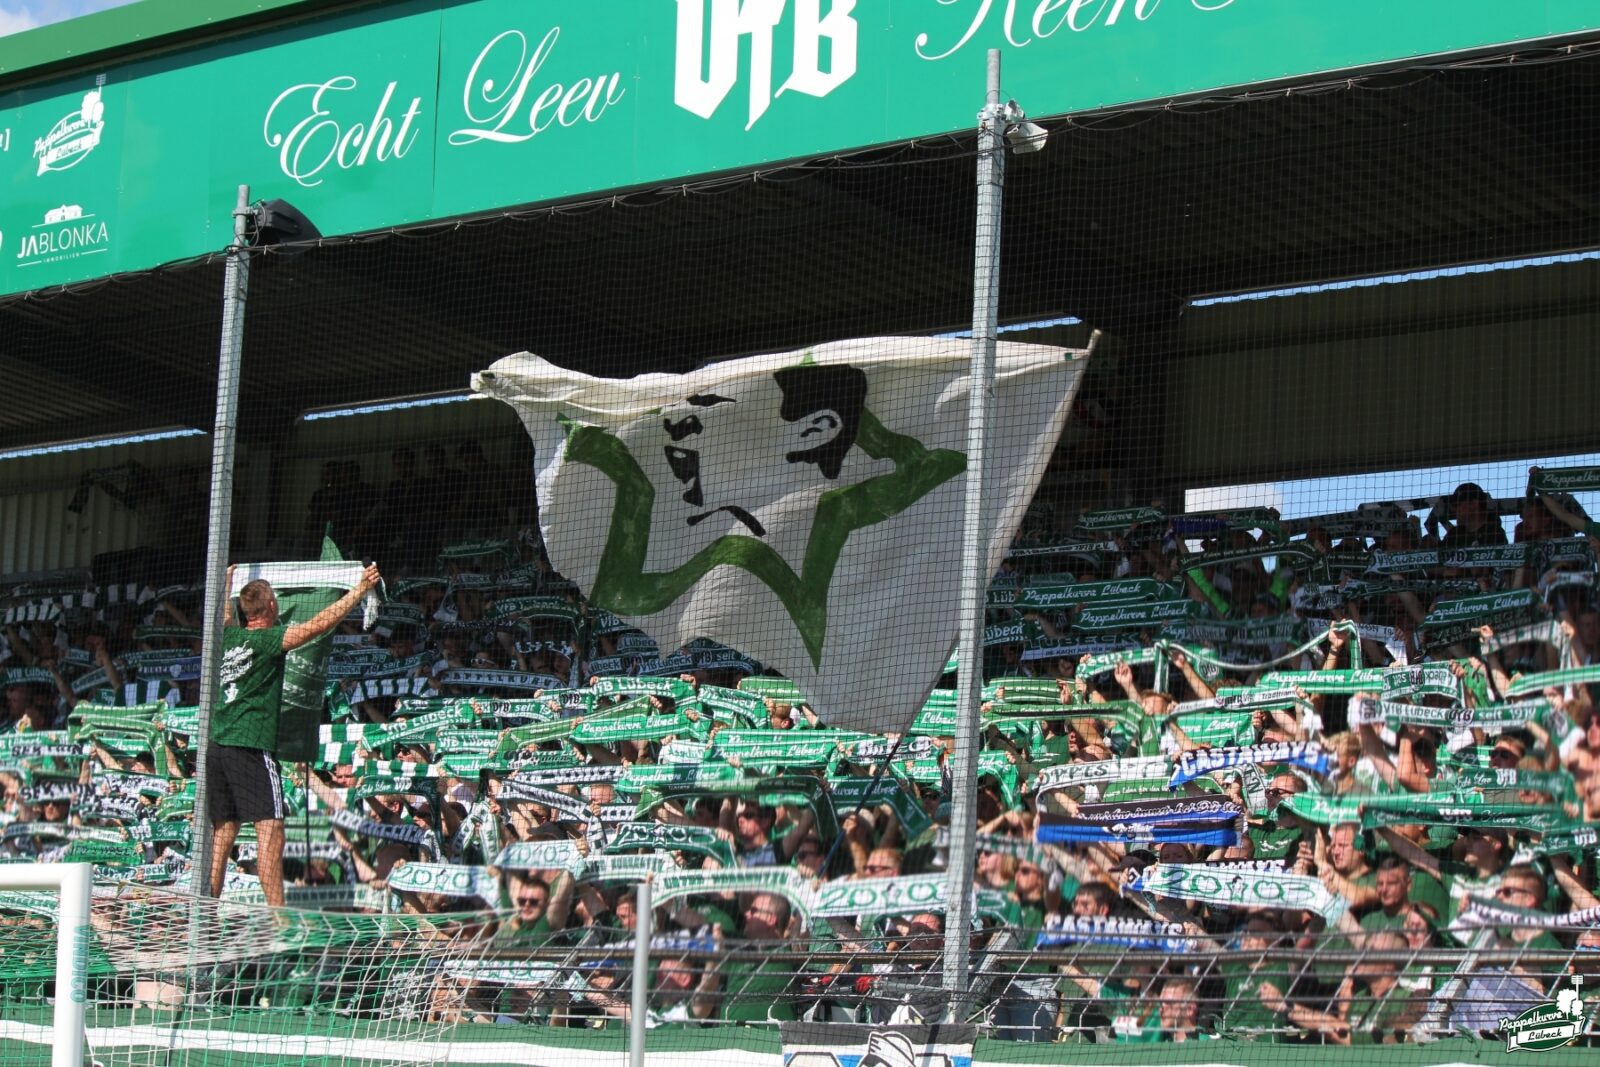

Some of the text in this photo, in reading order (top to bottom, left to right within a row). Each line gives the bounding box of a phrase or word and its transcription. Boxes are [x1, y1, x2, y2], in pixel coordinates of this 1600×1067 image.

[264, 76, 421, 187] Echt
[448, 26, 625, 146] Leev
[17, 222, 109, 258] JABLONKA
[1024, 582, 1141, 604] Pappelkurve Lübeck
[1080, 602, 1188, 626] Pappelkurve Lübeck
[618, 677, 675, 691] Lübeck
[1267, 671, 1345, 687] Pappelkurve
[412, 705, 464, 728] Lübeck
[1405, 706, 1445, 719] Lübeck
[787, 744, 826, 757] Lübeck
